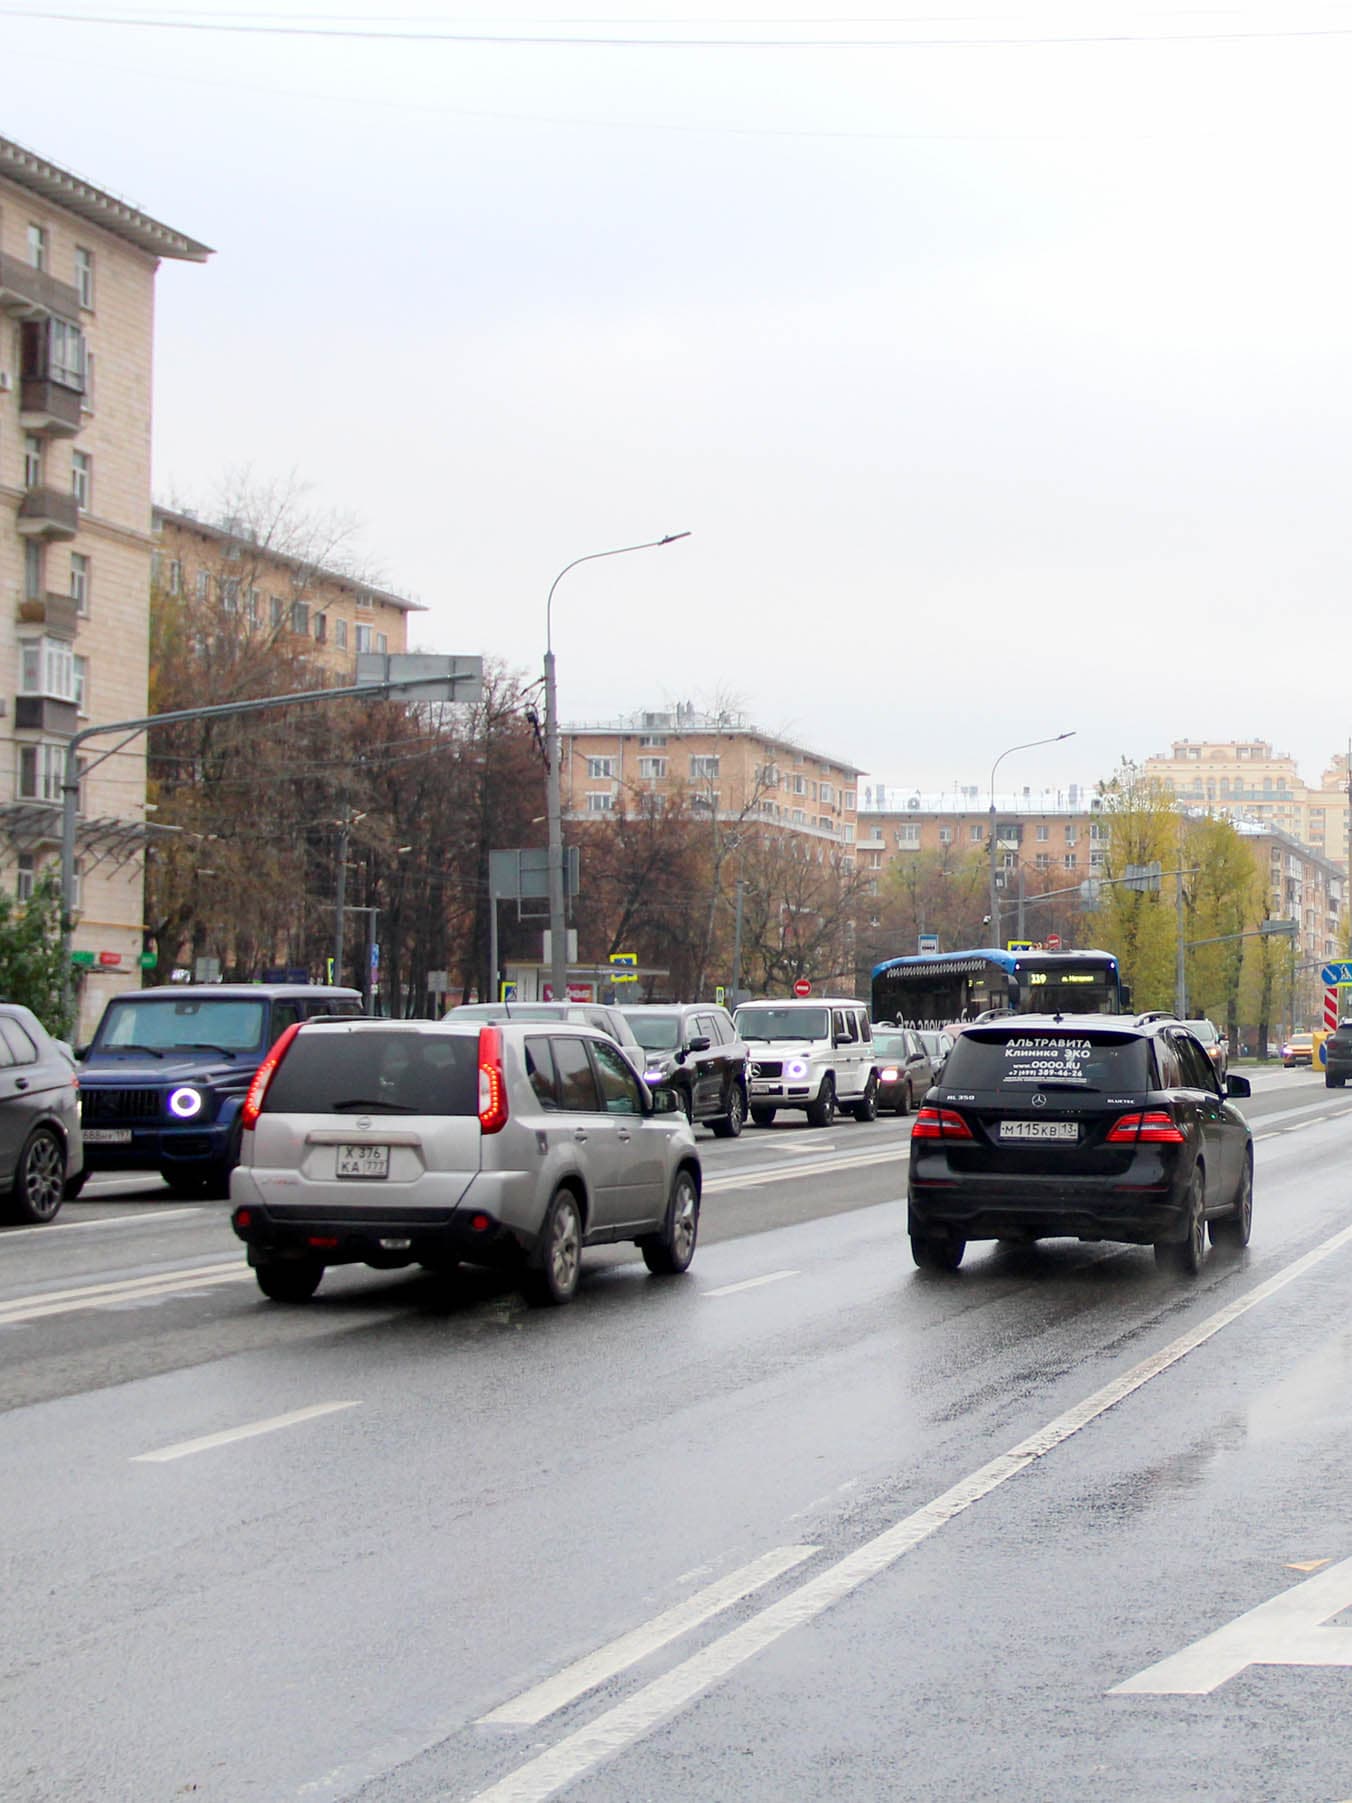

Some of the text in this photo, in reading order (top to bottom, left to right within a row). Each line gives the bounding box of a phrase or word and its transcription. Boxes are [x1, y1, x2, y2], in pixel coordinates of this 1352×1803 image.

[1031, 973, 1047, 984] 119
[1006, 1038, 1092, 1049] АЛЬТРАВИТА
[1005, 1049, 1091, 1058] Клиника ЭКО
[358, 1147, 381, 1159] 376
